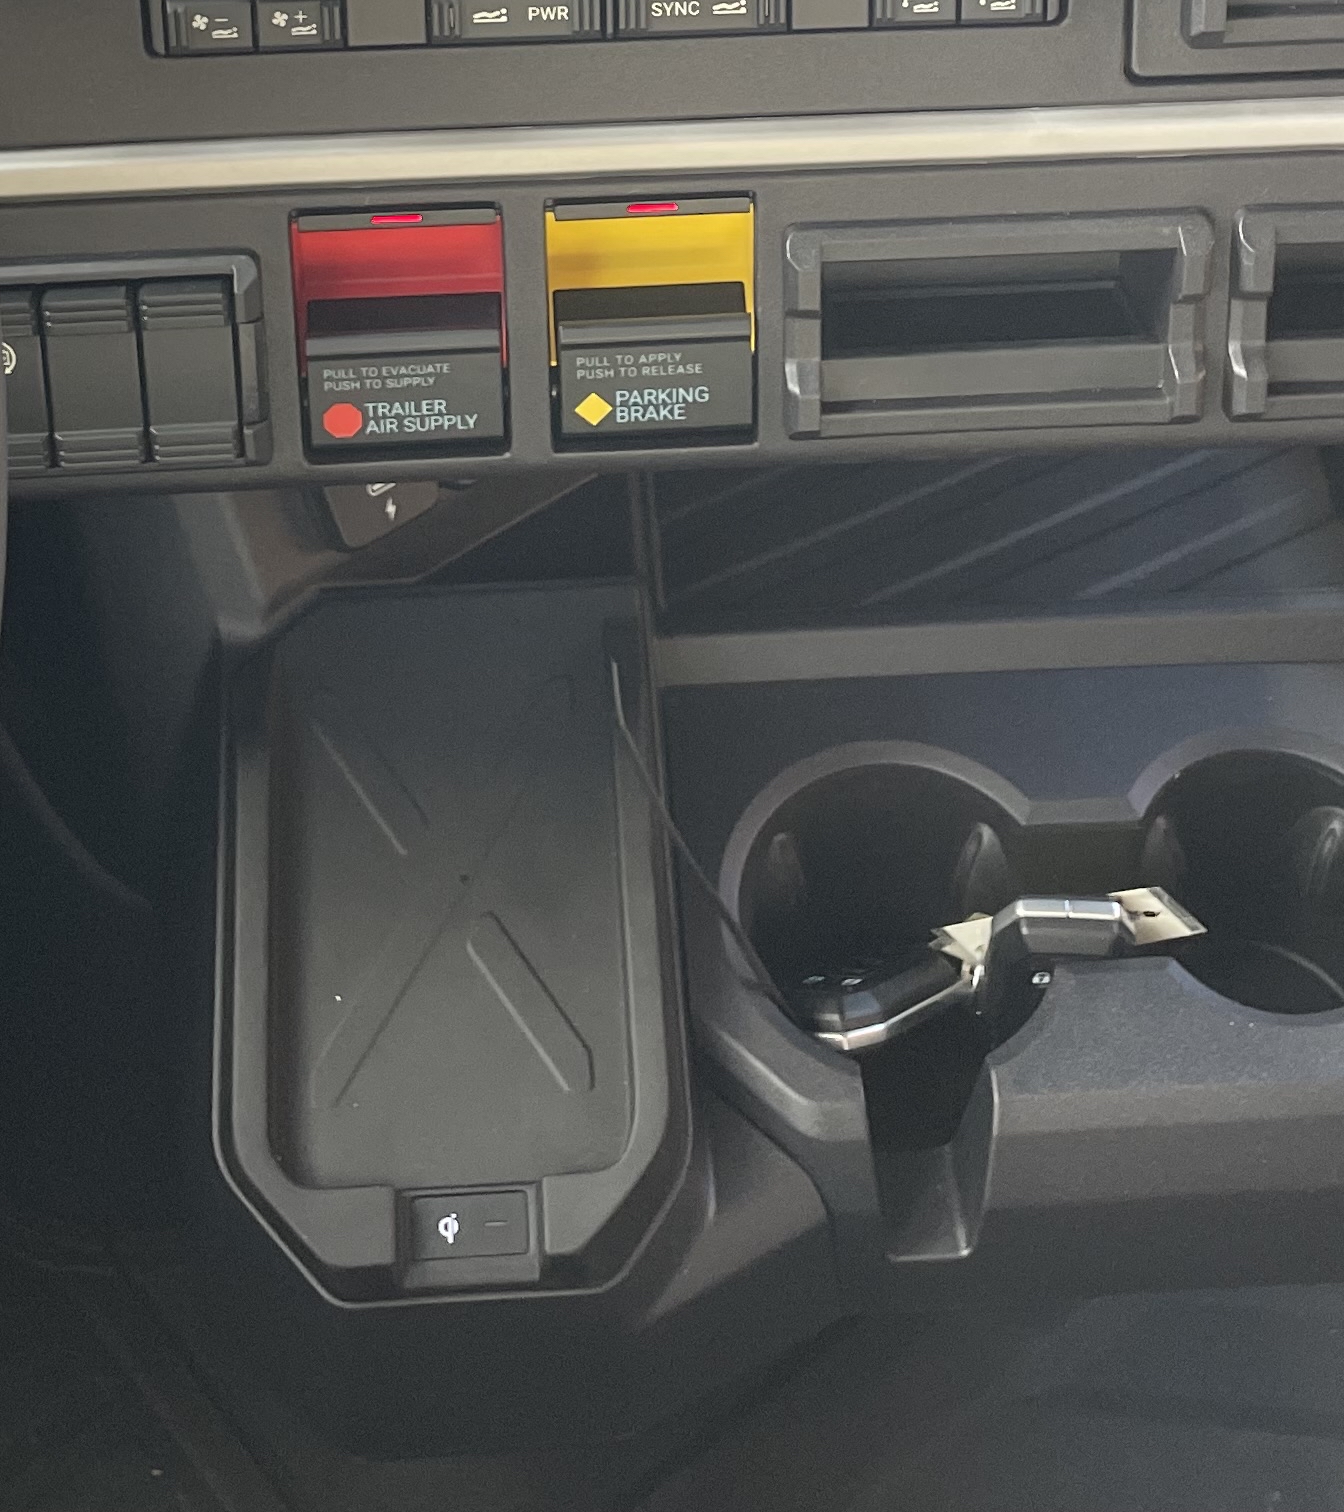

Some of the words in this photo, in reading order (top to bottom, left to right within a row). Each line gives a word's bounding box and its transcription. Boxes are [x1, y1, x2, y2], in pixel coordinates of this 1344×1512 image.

[527, 5, 569, 22] PWR
[651, 0, 701, 18] SYNC
[576, 355, 611, 368] PULL
[615, 354, 634, 366] TO
[638, 352, 683, 365] APPLY
[323, 368, 356, 380] PULL
[360, 366, 379, 378] TO
[382, 363, 451, 377] EVACUATE
[576, 367, 615, 380] PUSH
[618, 366, 638, 378] TO
[641, 363, 704, 377] RELEASE
[324, 379, 361, 392] PUSH
[364, 378, 382, 390] TO
[385, 376, 437, 389] SUPPLY
[615, 386, 710, 407] PARKING
[364, 399, 448, 418] TRAILER
[615, 403, 688, 424] BRAKE
[365, 417, 400, 435] AIR
[403, 413, 479, 433] SUPPLY
